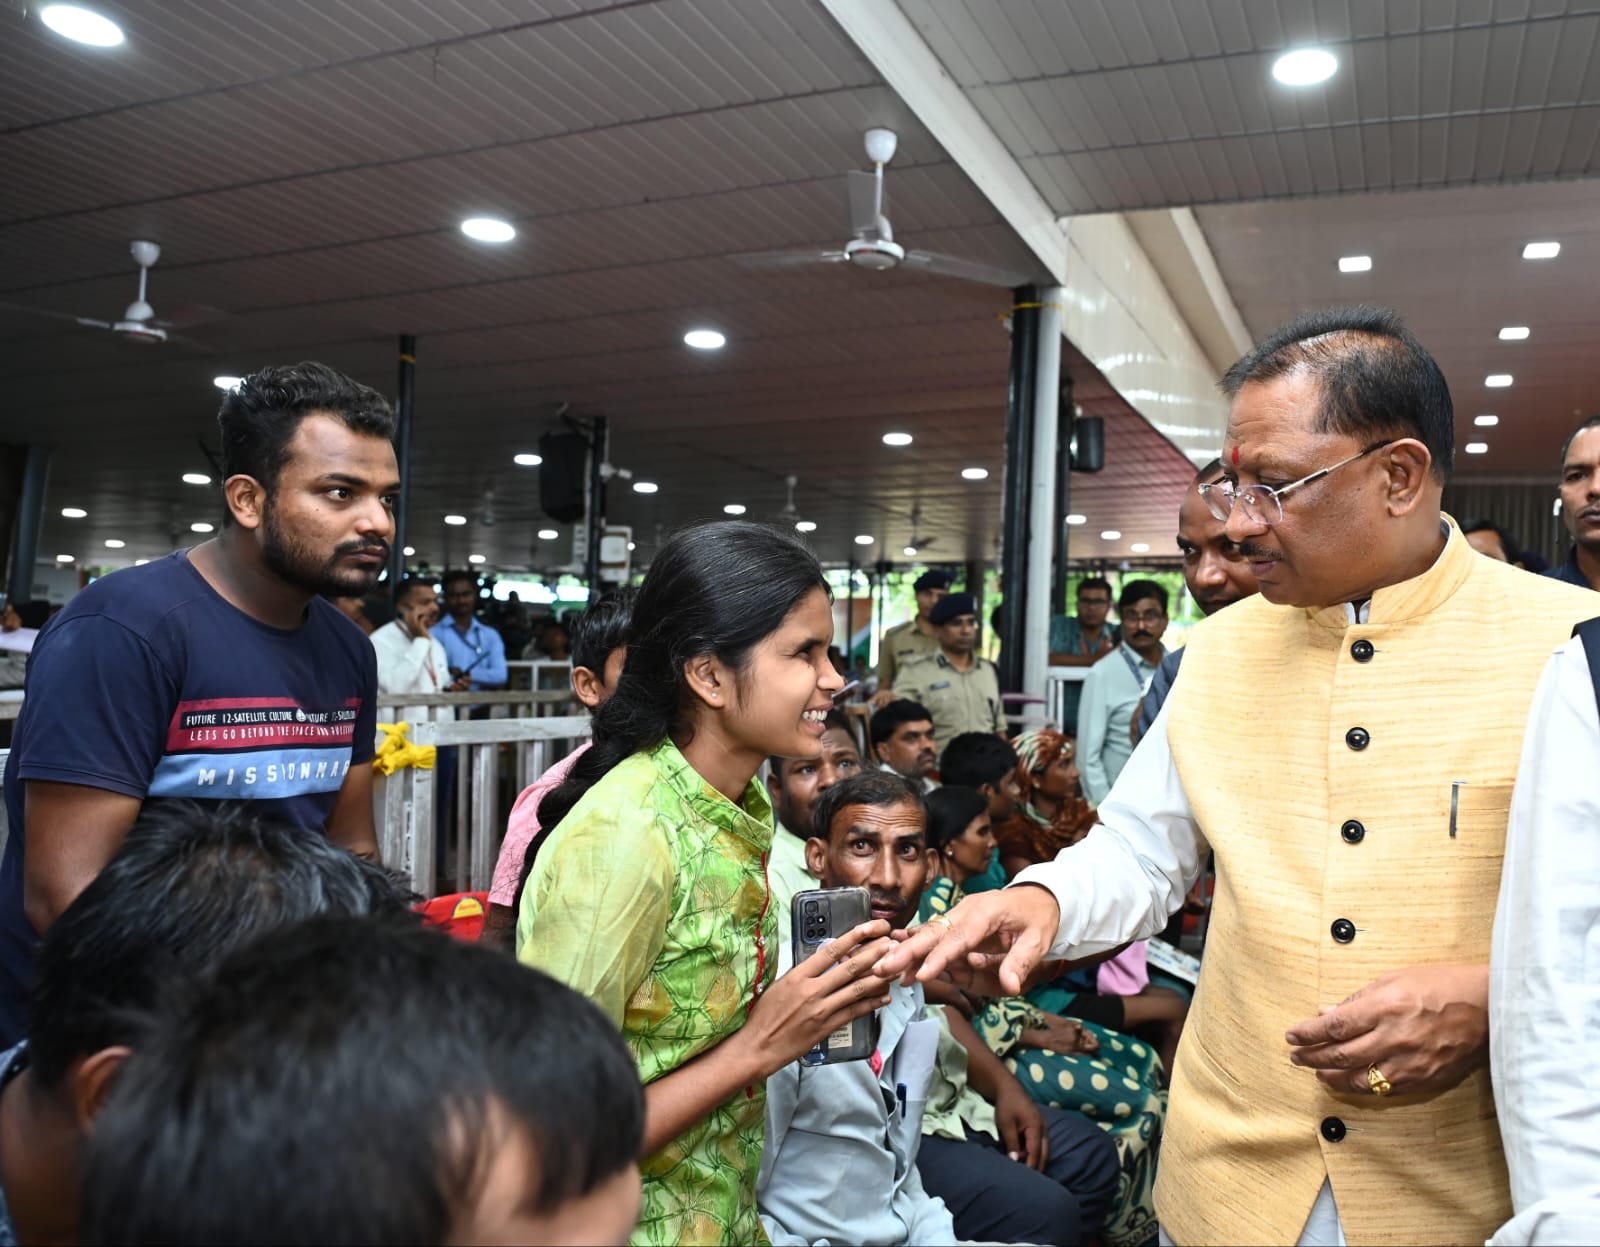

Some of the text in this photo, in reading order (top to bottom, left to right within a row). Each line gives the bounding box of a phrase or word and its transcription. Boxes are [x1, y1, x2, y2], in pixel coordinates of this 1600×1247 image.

[186, 713, 217, 726] FUTURE
[222, 711, 267, 724] 12-SATELLITE
[269, 711, 293, 721] CULTURE
[190, 730, 217, 741] LETS
[222, 729, 236, 740] GO
[241, 726, 274, 739] BEYOND
[277, 726, 289, 737] THE
[292, 726, 315, 737] SPACE
